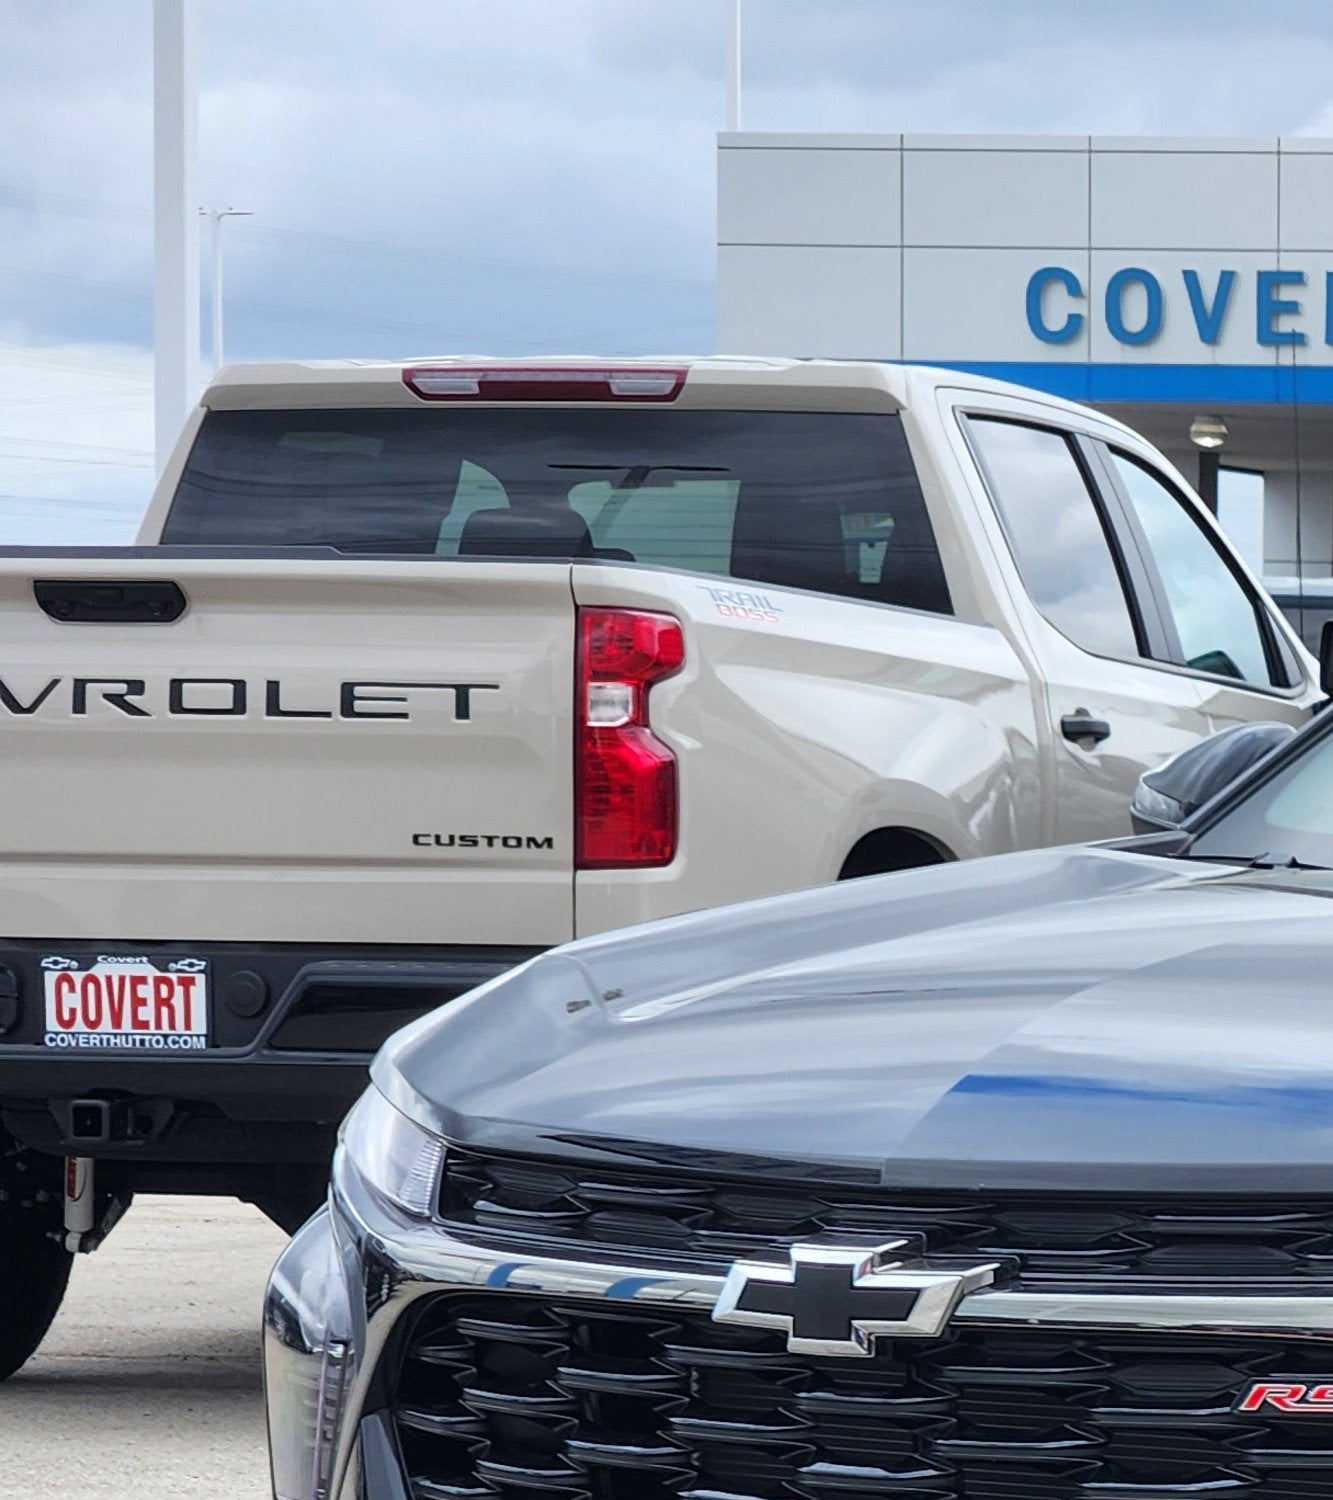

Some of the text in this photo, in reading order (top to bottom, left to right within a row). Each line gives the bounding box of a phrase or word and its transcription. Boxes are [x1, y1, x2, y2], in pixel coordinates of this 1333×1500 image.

[695, 584, 783, 612] TRAIL
[715, 603, 780, 624] BOSS
[411, 832, 554, 850] CUSTOM
[97, 955, 149, 964] Covert
[54, 972, 196, 1031] COVERT
[44, 1033, 206, 1049] COVERTHUTTO.COM
